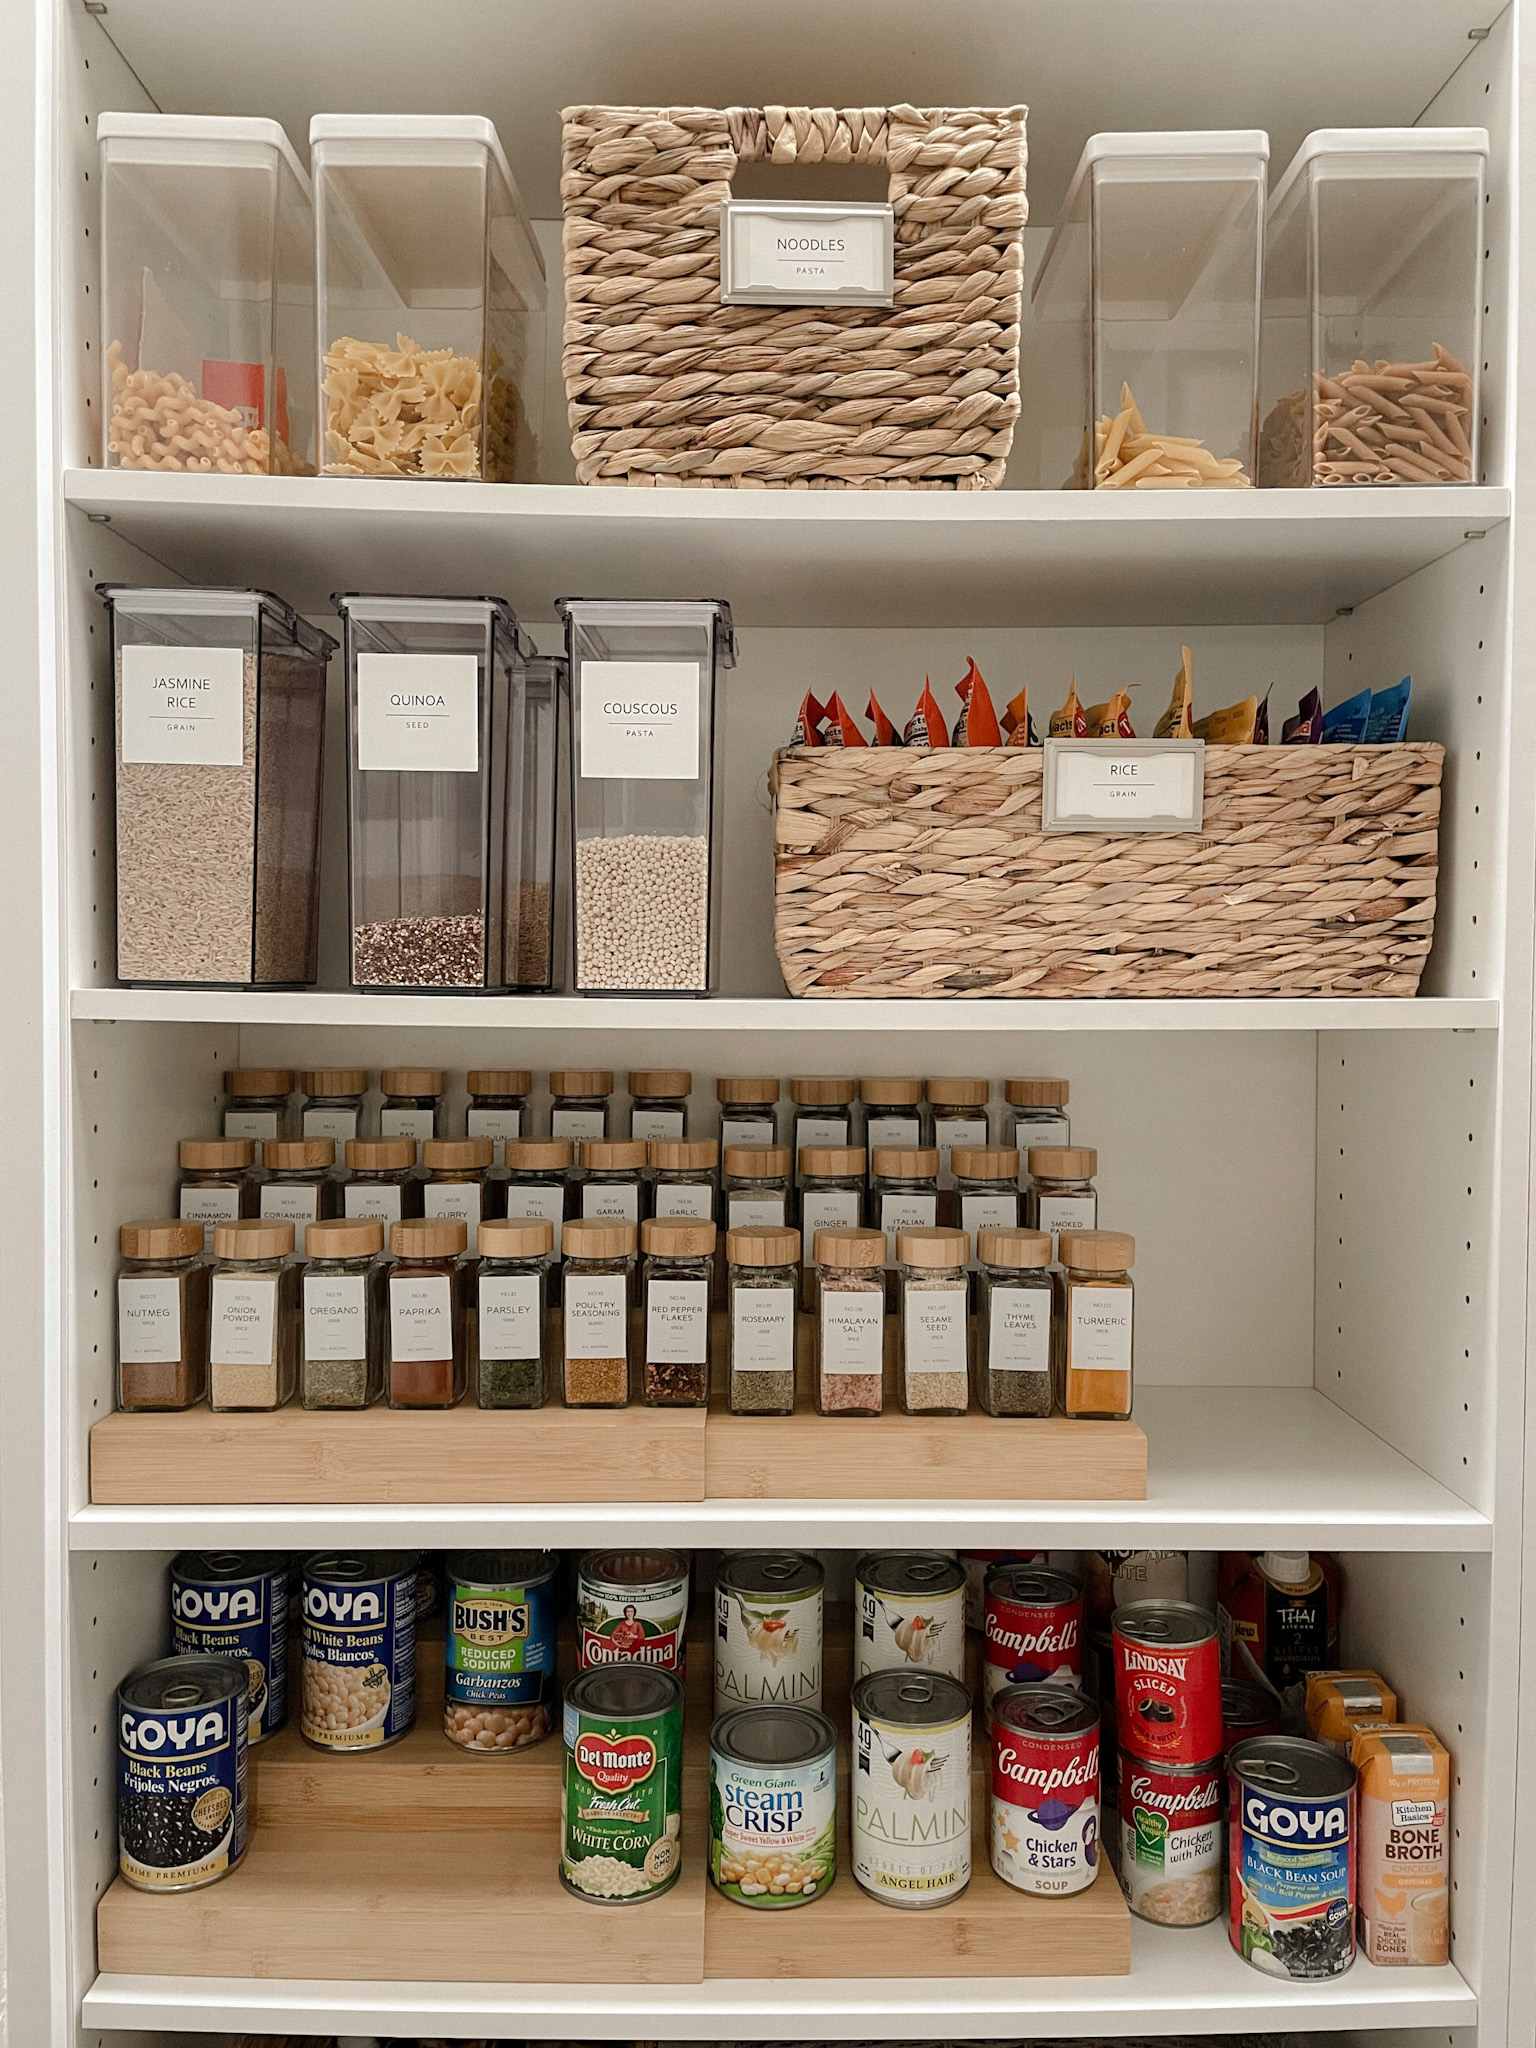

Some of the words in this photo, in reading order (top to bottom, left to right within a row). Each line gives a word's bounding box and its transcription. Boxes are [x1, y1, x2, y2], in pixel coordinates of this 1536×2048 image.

[777, 238, 845, 251] NOODLES
[796, 267, 825, 275] PASTA
[152, 678, 210, 690] JASMINE
[167, 697, 196, 709] RICE
[390, 694, 446, 707] QUINOA
[603, 702, 678, 714] COUSCOUS
[406, 721, 429, 729] SEED
[1110, 765, 1138, 776] RICE
[814, 1219, 848, 1228] GINGER
[227, 1306, 257, 1314] ONION
[309, 1306, 359, 1315] OREGANO
[399, 1307, 441, 1316] PAPRIKA
[486, 1306, 531, 1314] PARSLEY
[575, 1301, 616, 1309] POULTRY
[670, 1306, 703, 1314] PEPPER
[127, 1308, 170, 1318] NUTMEG
[222, 1314, 261, 1323] POWDER
[571, 1309, 620, 1317] SEASONING
[661, 1314, 693, 1322] FLAKES
[1006, 1313, 1036, 1321] THYME
[1004, 1321, 1037, 1329] LEAVES
[1077, 1316, 1127, 1326] TURMERIC
[1109, 1562, 1147, 1580] LITE
[172, 1583, 256, 1620] GOYA
[455, 1604, 526, 1632] BUSH'S
[1001, 1607, 1056, 1618] CONDENSED
[1277, 1608, 1316, 1623] THAI
[176, 1626, 198, 1645] Black
[202, 1634, 239, 1645] Beans
[985, 1611, 1077, 1656] Campbell's
[1234, 1623, 1255, 1637] New
[312, 1631, 343, 1647] White
[346, 1634, 383, 1647] Beans
[470, 1633, 504, 1641] BEST
[328, 1648, 375, 1662] Blancos
[461, 1646, 516, 1660] REDUCED
[586, 1638, 673, 1665] Contadina
[462, 1658, 511, 1670] SODIUM
[1124, 1648, 1186, 1681] LINDSAY
[455, 1672, 522, 1689] Garbanzos
[1134, 1678, 1176, 1697] SLICED
[466, 1689, 486, 1699] Chick
[489, 1691, 506, 1700] Peas
[121, 1712, 224, 1751] GOYA
[1021, 1740, 1082, 1751] CONDENSED
[580, 1746, 600, 1766] Del
[602, 1751, 651, 1769] Monte
[129, 1760, 161, 1778] Black
[165, 1762, 207, 1778] Beans
[124, 1773, 165, 1793] Frijoles
[168, 1775, 216, 1793] Negros
[597, 1771, 628, 1784] Quality
[731, 1773, 761, 1787] Green
[764, 1779, 794, 1788] Giant
[1408, 1778, 1440, 1787] PROTEIN
[725, 1784, 802, 1811] steam
[1131, 1775, 1219, 1815] Campbell's
[589, 1796, 617, 1810] Fresh
[618, 1798, 642, 1811] Cut
[1396, 1805, 1432, 1814] Kitchen
[726, 1805, 802, 1833] CRISP
[1136, 1813, 1162, 1829] Healthy
[1247, 1798, 1345, 1839] GOYA
[1401, 1814, 1430, 1822] Basics
[572, 1825, 610, 1850] WHITE
[613, 1833, 652, 1850] CORN
[725, 1826, 739, 1838] Super
[740, 1831, 758, 1843] Sweet
[760, 1836, 781, 1845] Yellow
[786, 1834, 805, 1843] White
[1171, 1830, 1212, 1850] Chicken
[1390, 1829, 1439, 1844] BONE
[1026, 1838, 1077, 1853] Chicken
[1171, 1850, 1192, 1863] with
[1194, 1841, 1214, 1856] Rice
[1386, 1843, 1442, 1860] BROTH
[654, 1847, 670, 1860] NON
[654, 1856, 670, 1870] GMO
[1028, 1853, 1039, 1867] &
[1042, 1855, 1076, 1868] Stars
[1247, 1855, 1282, 1880] BLACK
[1286, 1869, 1318, 1883] BEAN
[1321, 1867, 1347, 1882] SOUP
[1392, 1865, 1438, 1873] CHICKEN
[880, 1875, 923, 1889] ANGEL
[927, 1873, 956, 1889] HAIR
[1035, 1881, 1068, 1890] SOUP
[1328, 1909, 1347, 1921] GOYA
[1377, 1936, 1406, 1945] CHICKEN
[1377, 1943, 1406, 1953] BONES
